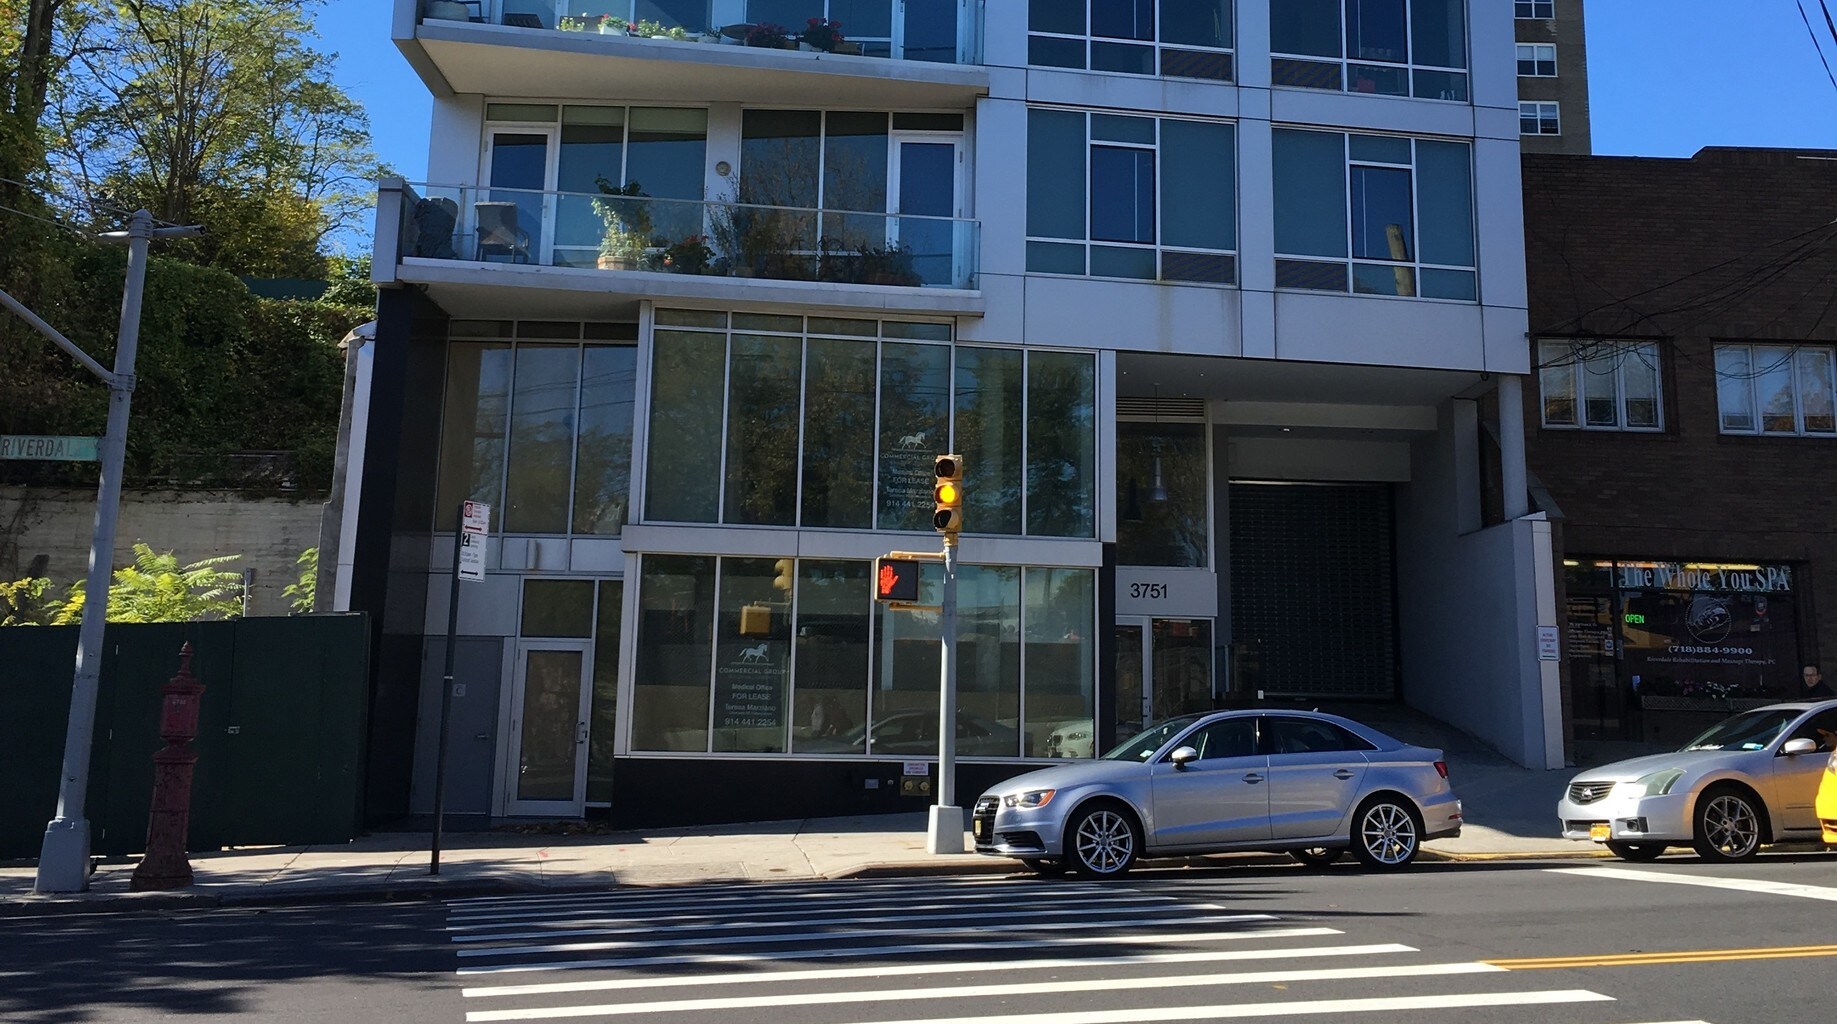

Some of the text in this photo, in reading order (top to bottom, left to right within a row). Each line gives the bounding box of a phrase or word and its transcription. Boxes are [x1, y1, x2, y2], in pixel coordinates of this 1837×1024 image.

[908, 477, 930, 485] LEASE
[886, 499, 900, 507] 914
[463, 532, 469, 545] 2
[1621, 564, 1791, 591] The Whole You SPA
[1130, 582, 1167, 599] 3751
[1625, 613, 1645, 624] OPEN
[1668, 645, 1753, 655] (718)884-9900
[719, 667, 762, 675] COMMERCIAL
[732, 692, 747, 700] FOR
[741, 718, 755, 726] 441
[757, 718, 776, 726] 2254
